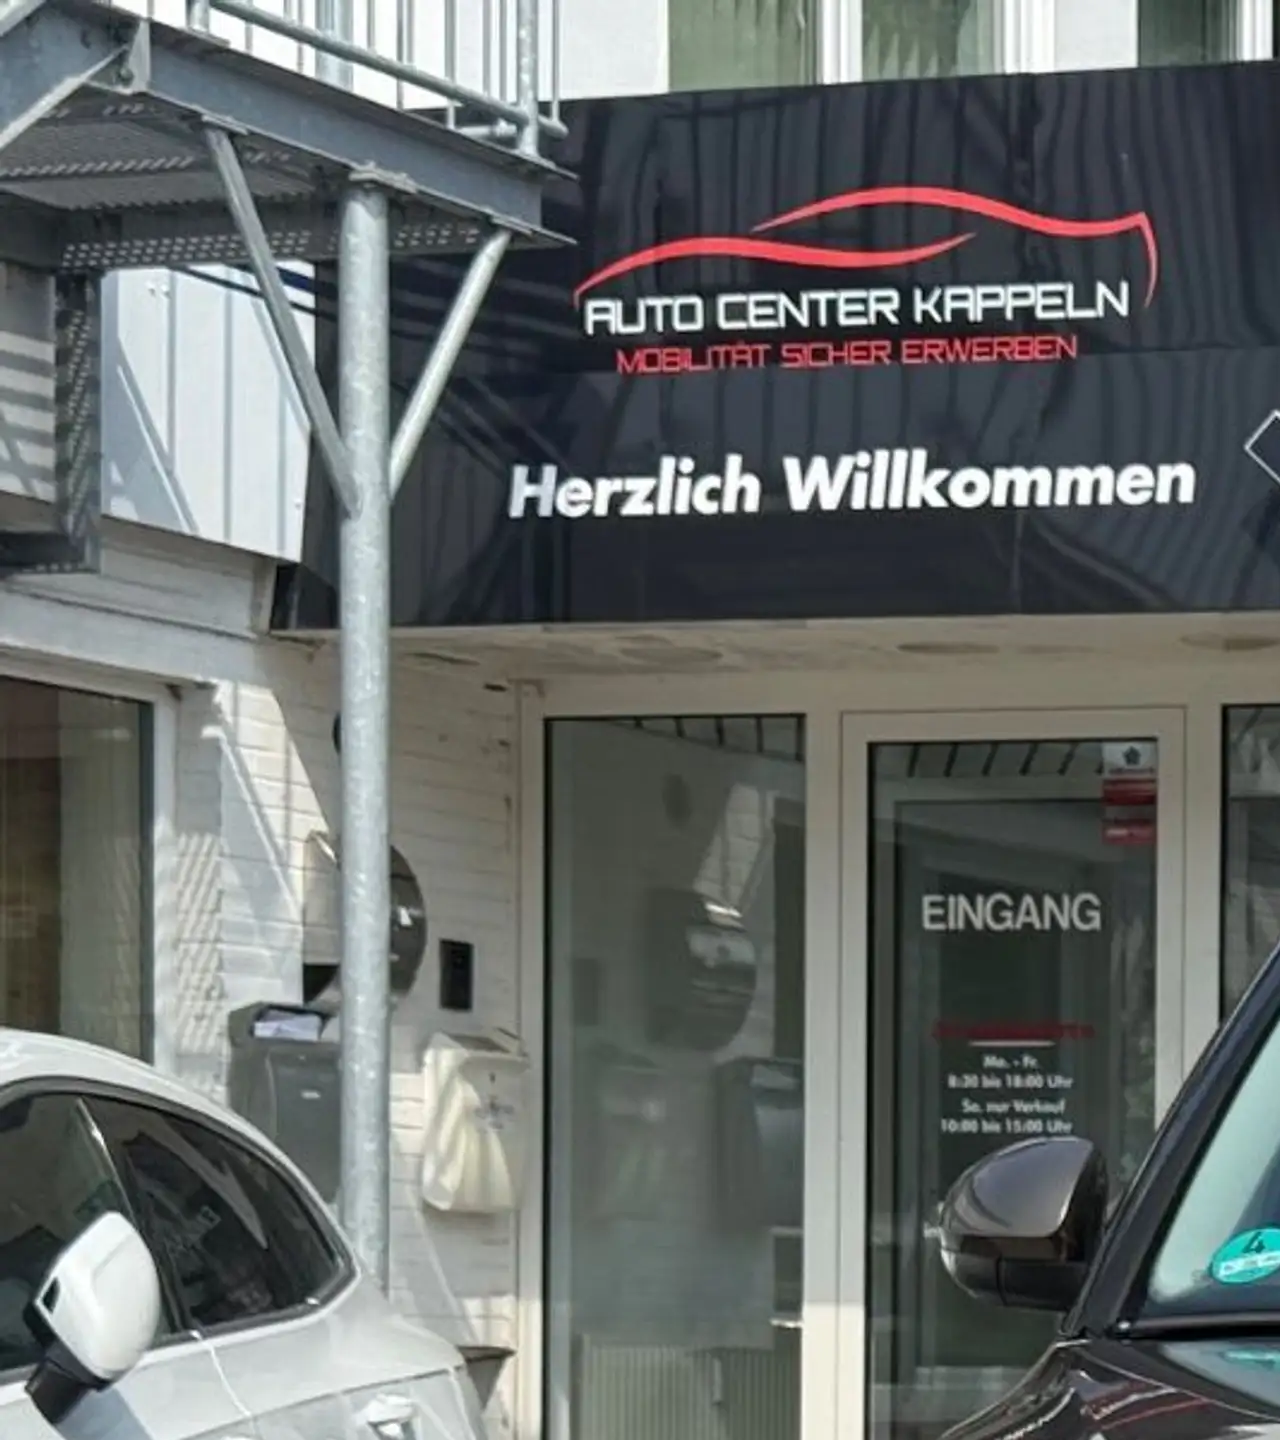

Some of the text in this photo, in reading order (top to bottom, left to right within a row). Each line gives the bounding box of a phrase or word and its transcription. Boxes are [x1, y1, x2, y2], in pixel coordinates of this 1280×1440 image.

[585, 280, 1129, 335] AUTO CENTER KAPPELN
[781, 340, 892, 369] SICHER
[901, 335, 1077, 364] ERWERBEN
[509, 447, 1196, 518] Herzlich Willkommen
[921, 892, 1101, 931] EINGANG
[1242, 1231, 1266, 1254] 4
